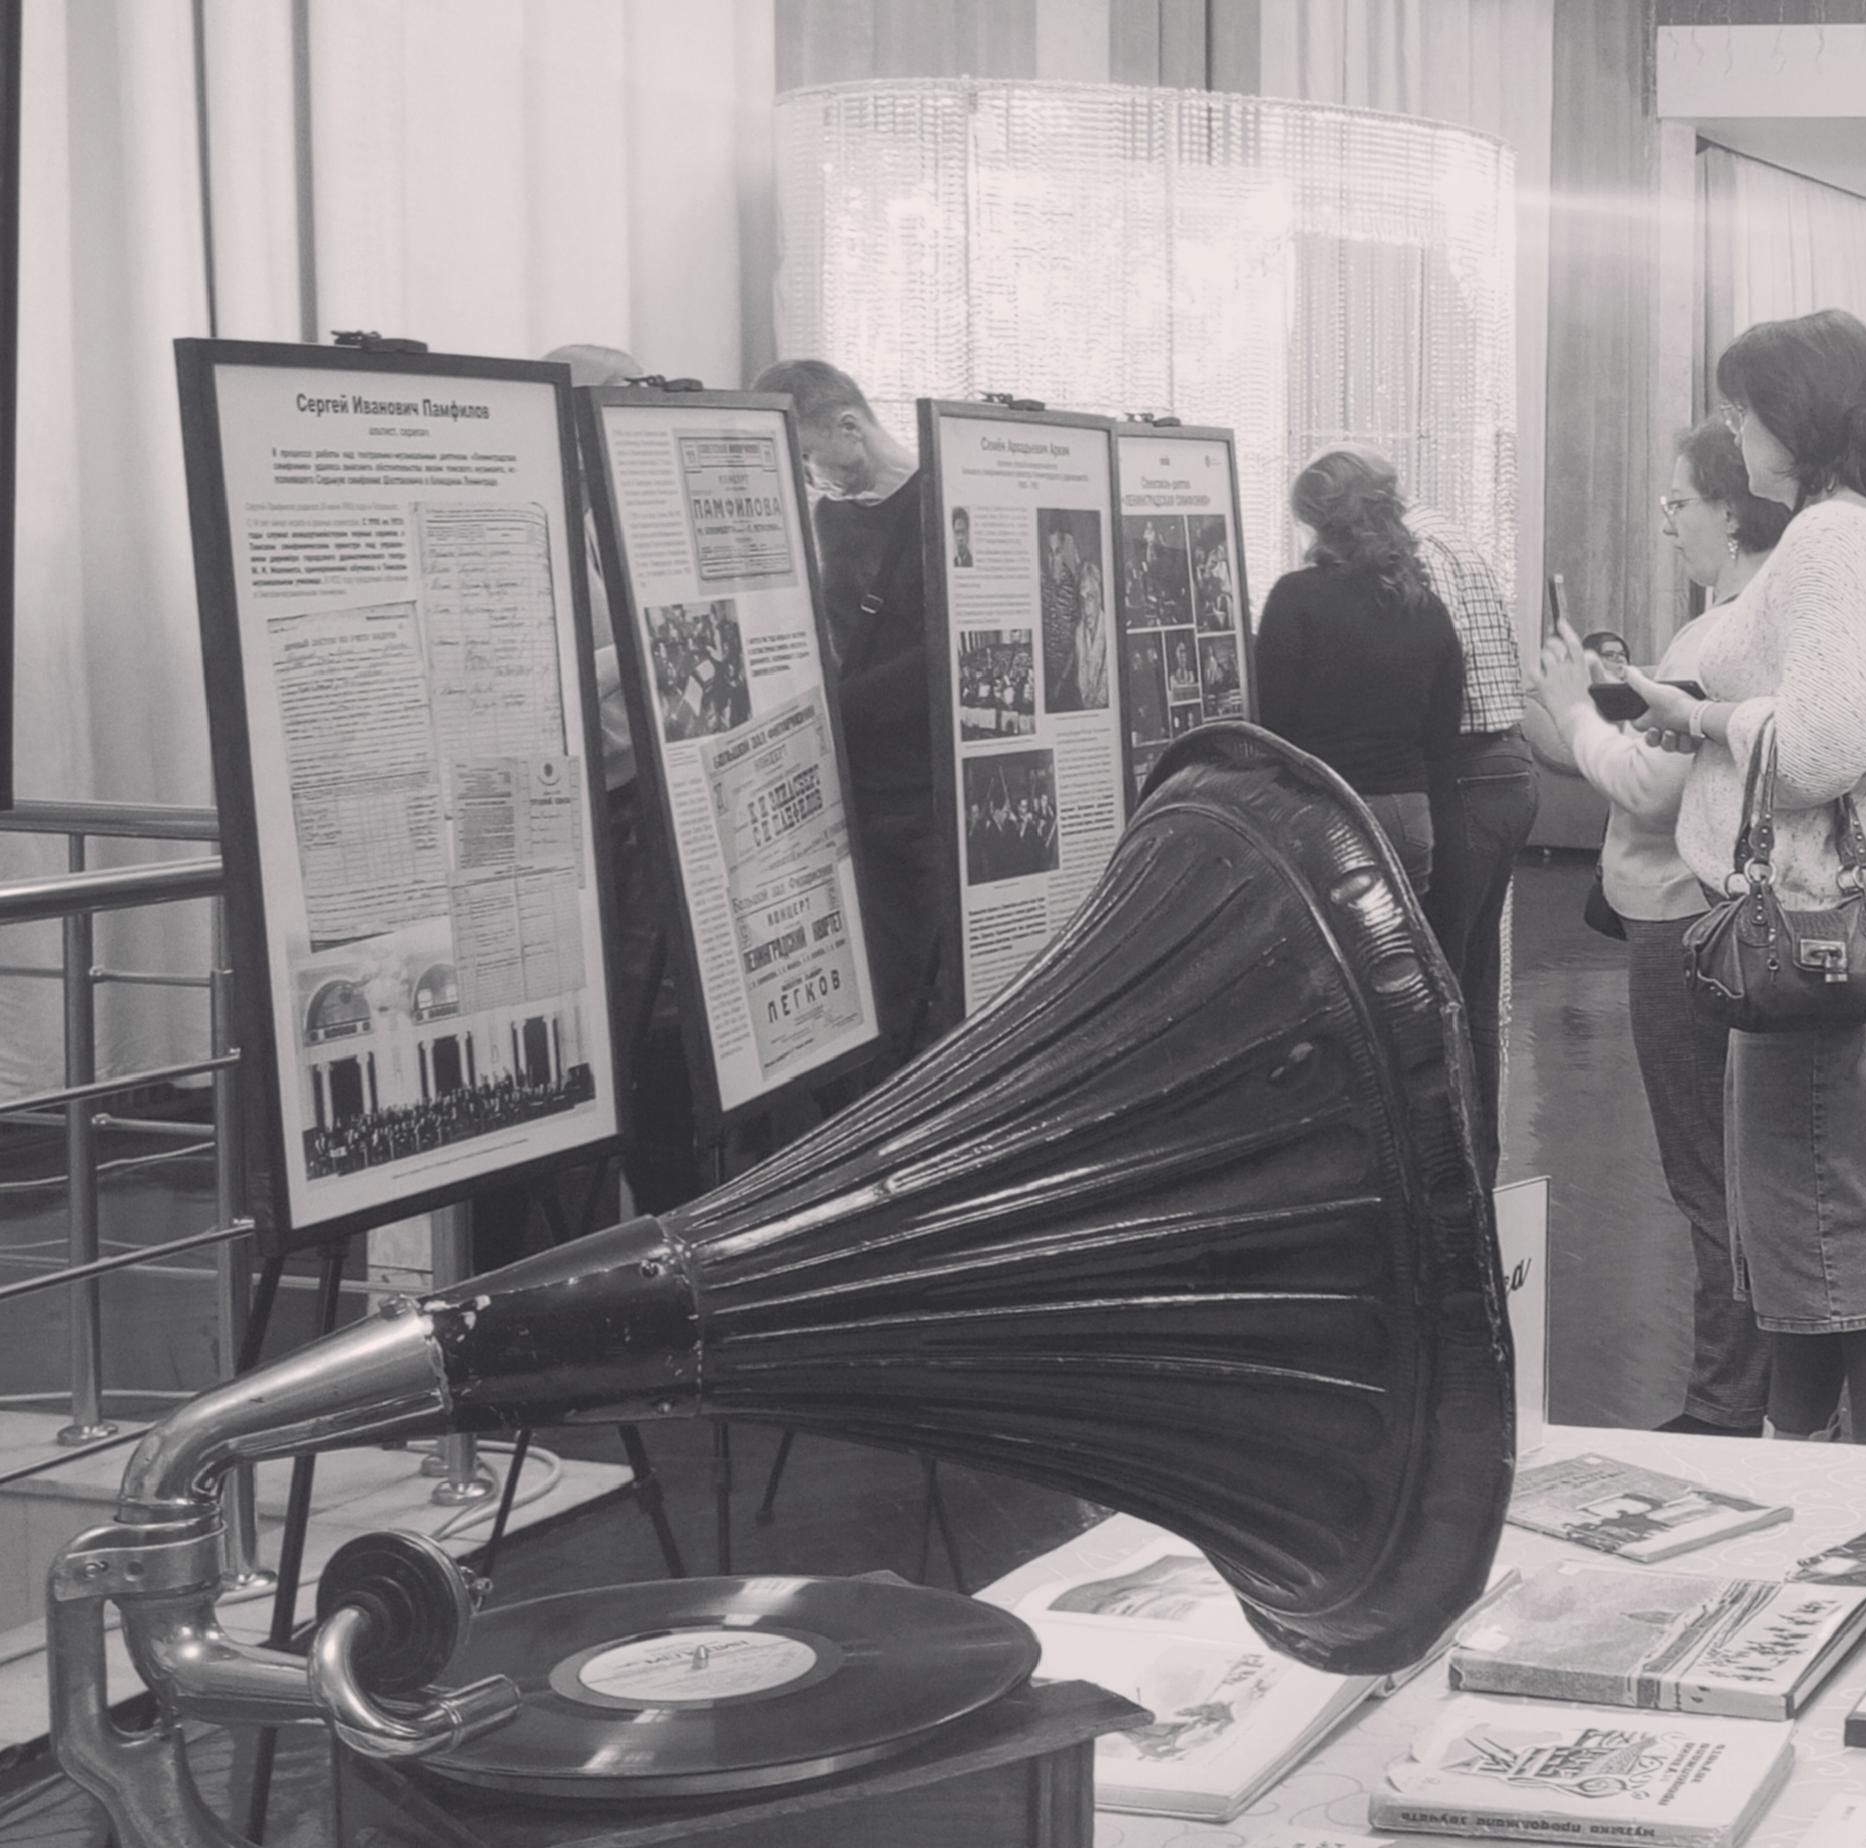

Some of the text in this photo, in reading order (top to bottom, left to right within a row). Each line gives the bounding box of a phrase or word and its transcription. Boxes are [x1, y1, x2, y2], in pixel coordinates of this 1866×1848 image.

[296, 393, 490, 421] Сергей Иванович Памфилов
[1400, 1811, 1655, 1839] музыка продолжала звучать
